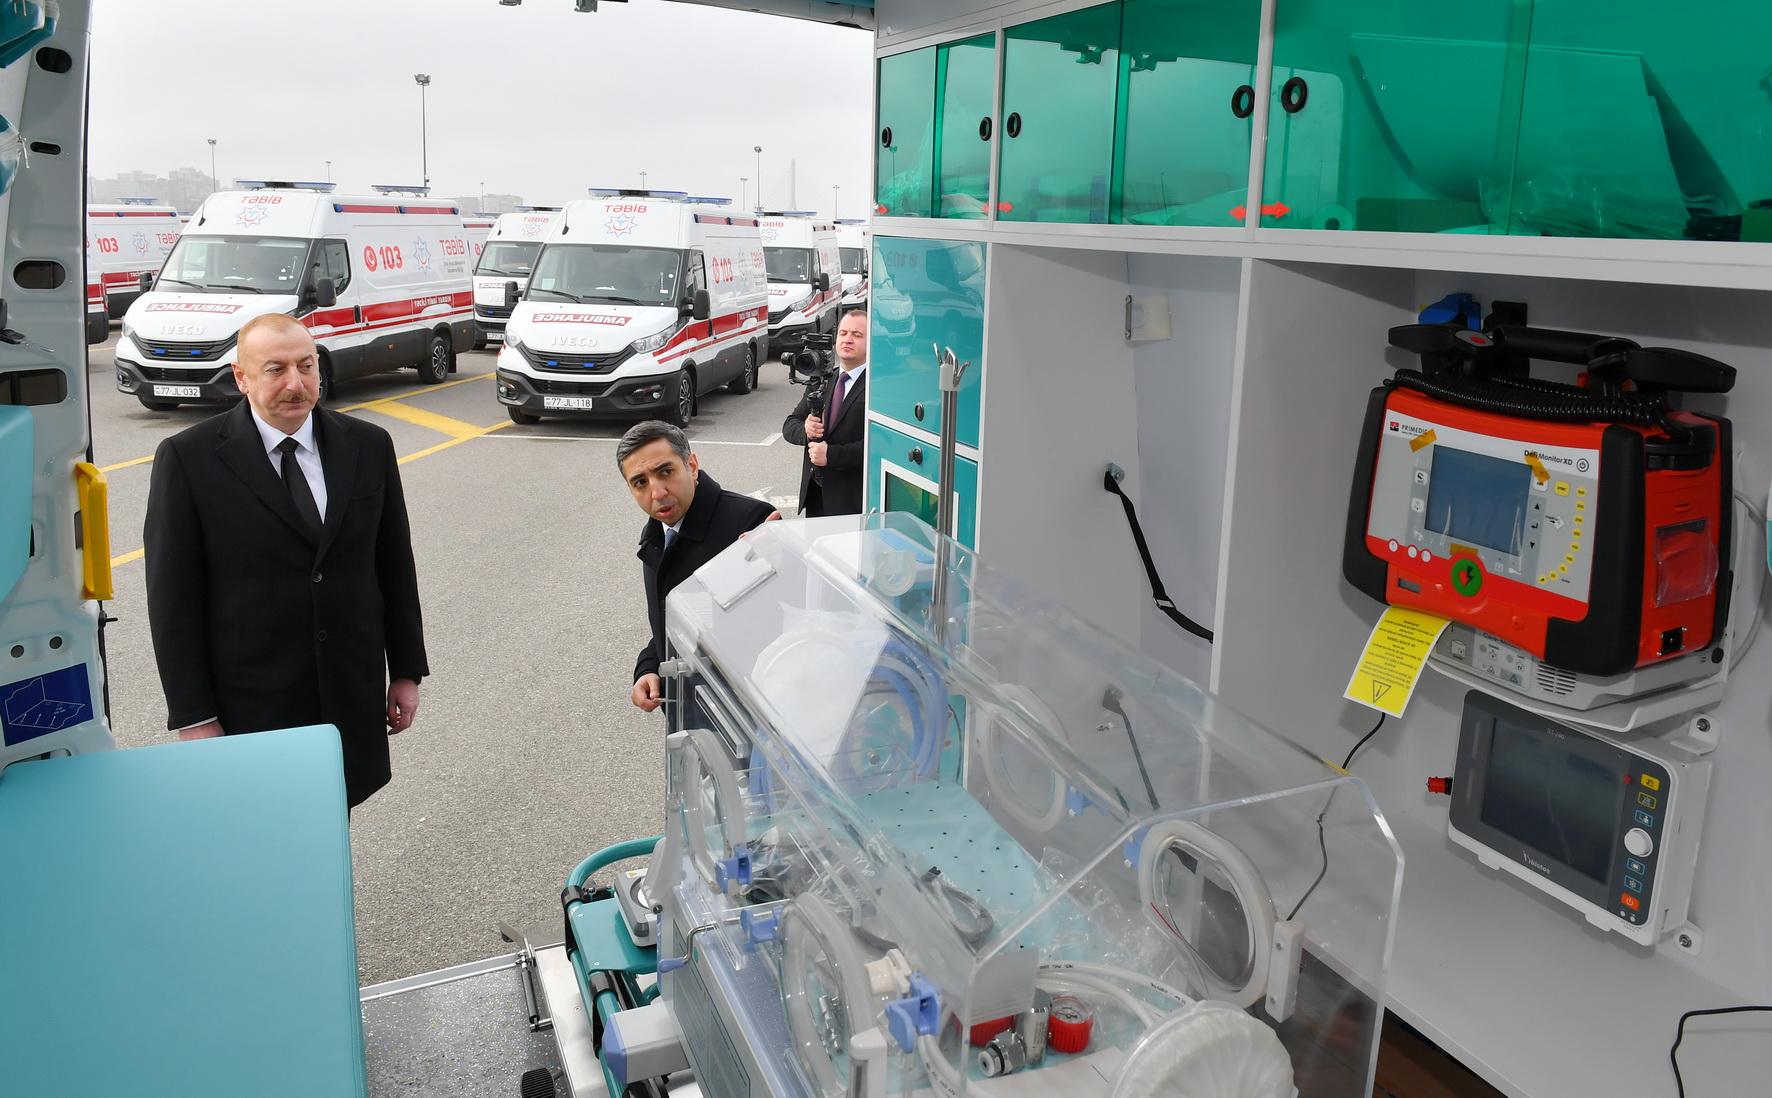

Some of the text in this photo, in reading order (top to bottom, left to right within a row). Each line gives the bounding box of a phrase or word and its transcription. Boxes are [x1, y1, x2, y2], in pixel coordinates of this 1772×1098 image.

[97, 237, 119, 254] 103
[379, 245, 403, 270] 103
[720, 257, 733, 282] 103
[160, 323, 205, 335] IVECO
[551, 336, 598, 347] IVECO
